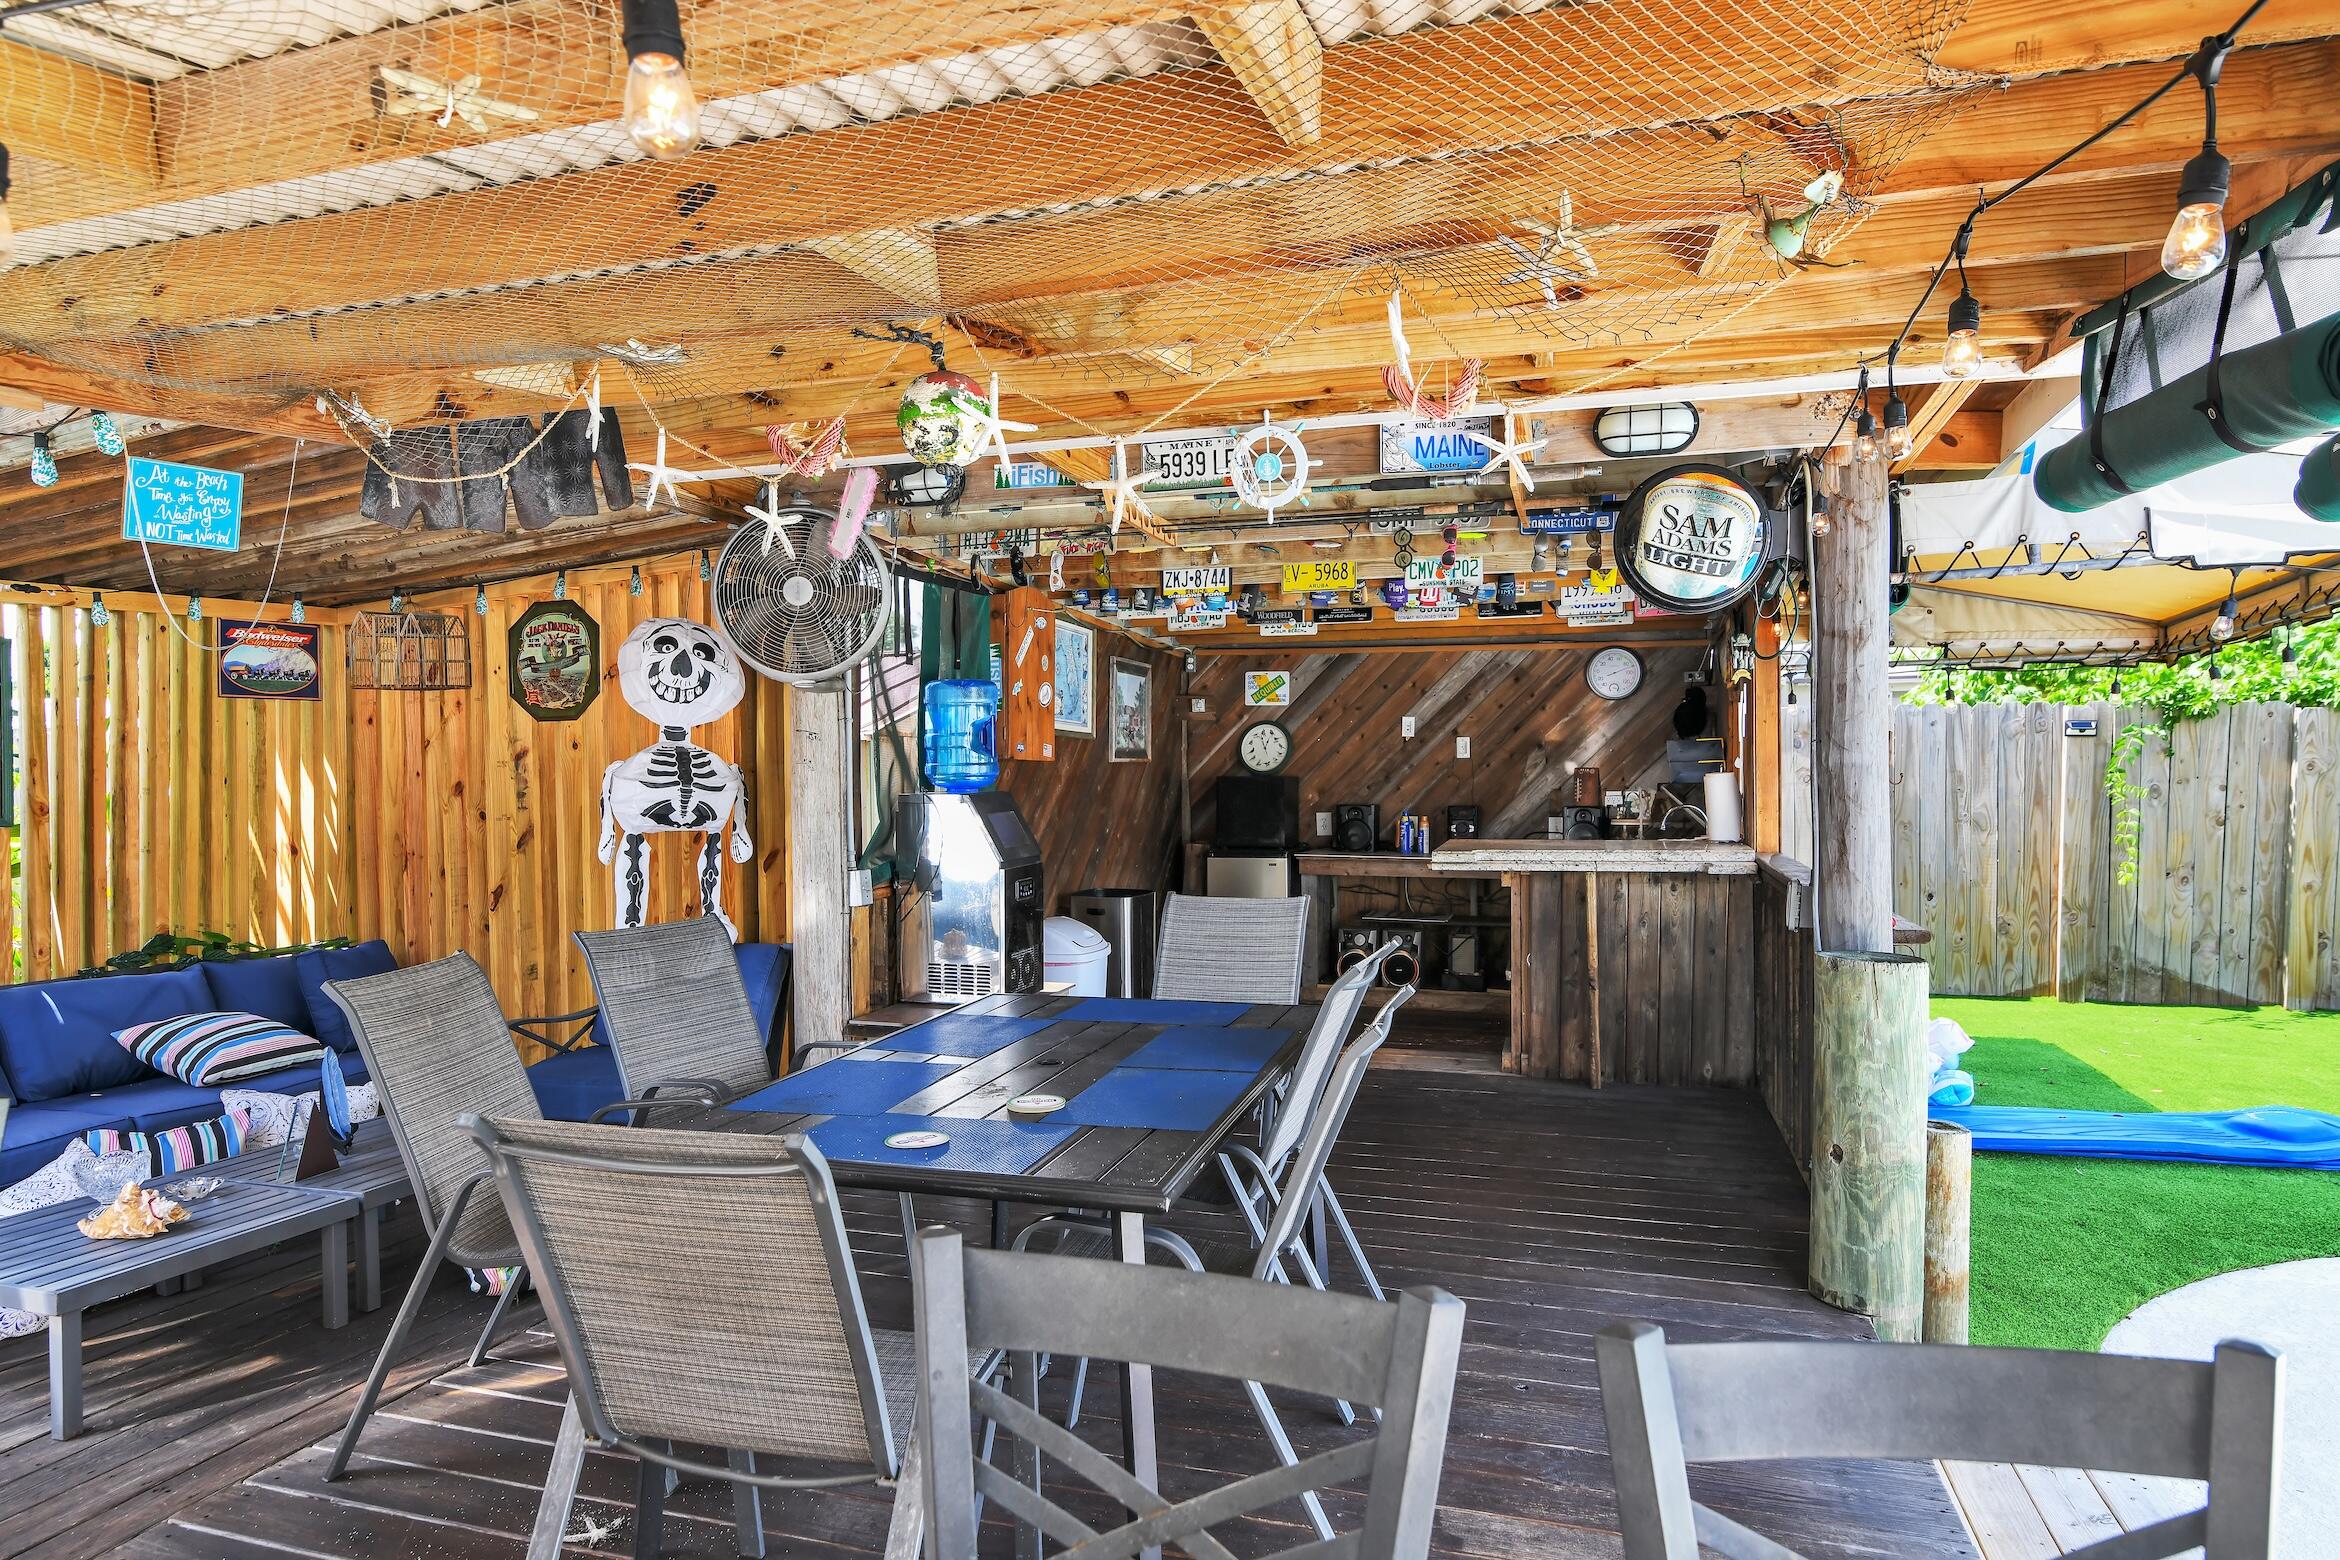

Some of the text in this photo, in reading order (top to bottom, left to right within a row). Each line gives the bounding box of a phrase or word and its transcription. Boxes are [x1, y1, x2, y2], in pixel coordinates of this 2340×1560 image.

[1169, 440, 1213, 450] MAINE
[1415, 433, 1485, 459] MAINE
[1011, 464, 1058, 487] iFish
[1161, 451, 1206, 479] 5939
[135, 465, 228, 491] At the Beach
[148, 487, 232, 514] Time you Enjoy
[156, 504, 212, 528] Wasting
[1660, 504, 1736, 539] SAM
[146, 521, 177, 539] NOT
[195, 528, 231, 545] Wasted
[1651, 528, 1732, 557] ADAMS
[1315, 562, 1349, 582] 5968
[1409, 560, 1435, 580] CMV
[1649, 546, 1728, 577] LIGHT
[1388, 582, 1405, 594] Play.
[1257, 611, 1293, 619] WOODFIELD
[230, 629, 308, 643] Budweiser
[1252, 677, 1284, 703] REQUIRED
